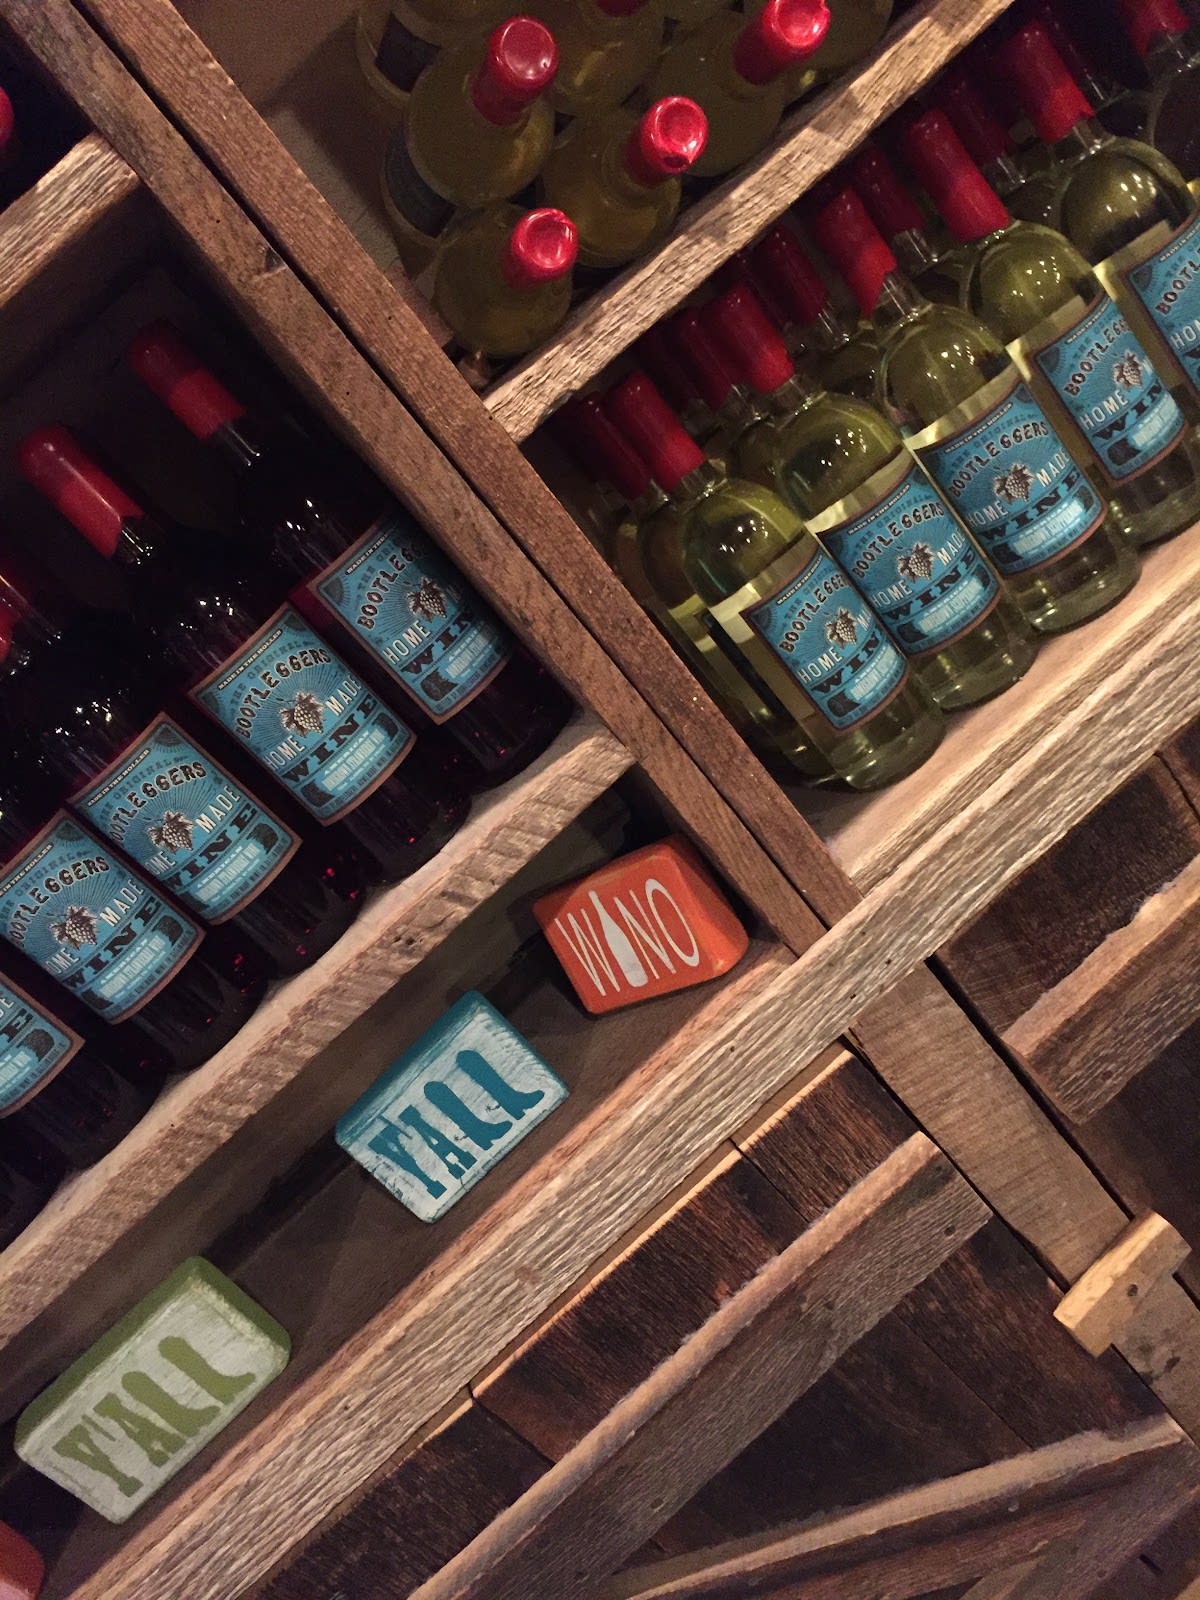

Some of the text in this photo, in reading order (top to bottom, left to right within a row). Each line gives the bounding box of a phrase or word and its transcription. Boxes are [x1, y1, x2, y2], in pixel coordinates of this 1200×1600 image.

[1080, 389, 1129, 430] HOME
[1093, 379, 1162, 440] WIN
[949, 421, 1049, 497] BOOTLEGGERS
[967, 447, 1071, 527] HOME MADE
[852, 502, 945, 578] BOOTLEGGERS
[977, 466, 1082, 540] WINE
[872, 579, 912, 607] HOME
[881, 548, 977, 620] WINE
[217, 629, 283, 690] MADE IN THE HOLLER
[382, 620, 431, 665] HOME
[798, 646, 843, 684] HOME
[233, 648, 331, 738] BOOTLEGGERS
[266, 735, 305, 770] HOME
[325, 677, 362, 716] MADE
[282, 694, 378, 782] WINE
[110, 761, 207, 842] OOTLEGGERS
[147, 851, 176, 876] OME
[195, 785, 240, 833] MADE
[11, 856, 110, 947] OOTLEGGERS
[46, 947, 80, 974] OME
[100, 879, 145, 927] MADE
[63, 896, 161, 987] WINE
